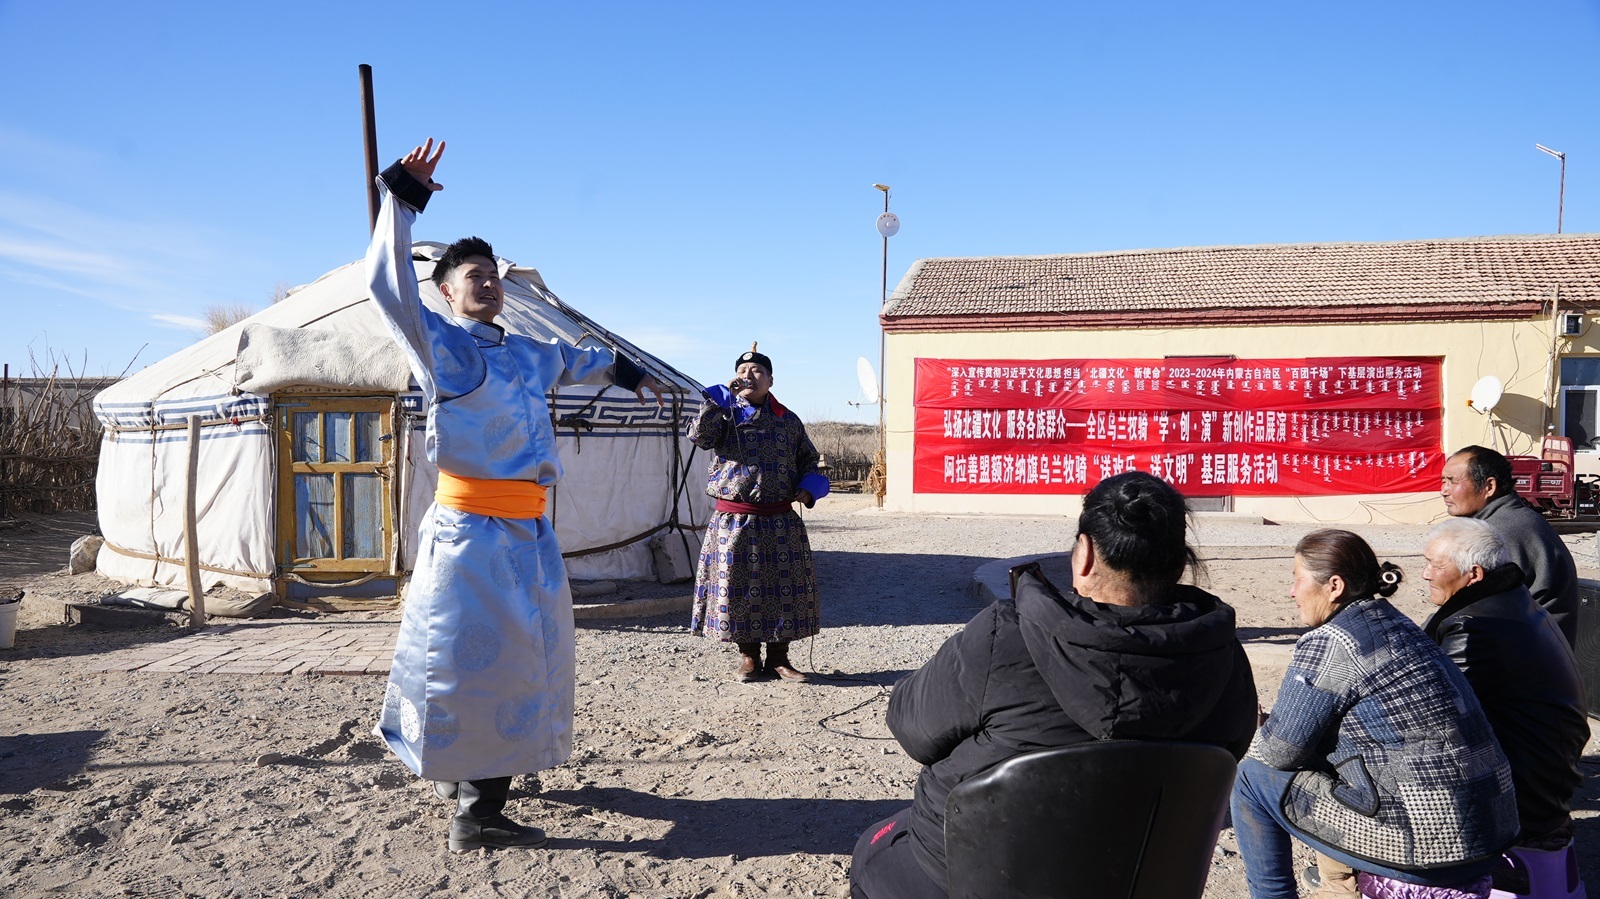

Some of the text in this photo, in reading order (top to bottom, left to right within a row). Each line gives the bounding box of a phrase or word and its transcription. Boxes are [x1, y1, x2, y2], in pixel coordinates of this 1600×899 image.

[1063, 367, 1081, 380] 担当
[1168, 367, 1281, 380] 2023-2024年内蒙古自治区
[1337, 366, 1422, 380] 下基层演出服务活动
[943, 408, 1001, 439] 弘扬北疆文化
[1222, 410, 1287, 443] 新创作品展演
[943, 453, 1087, 485] 阿拉善盟额济纳旗乌兰牧骑
[1200, 452, 1279, 485] 基层服务活动
